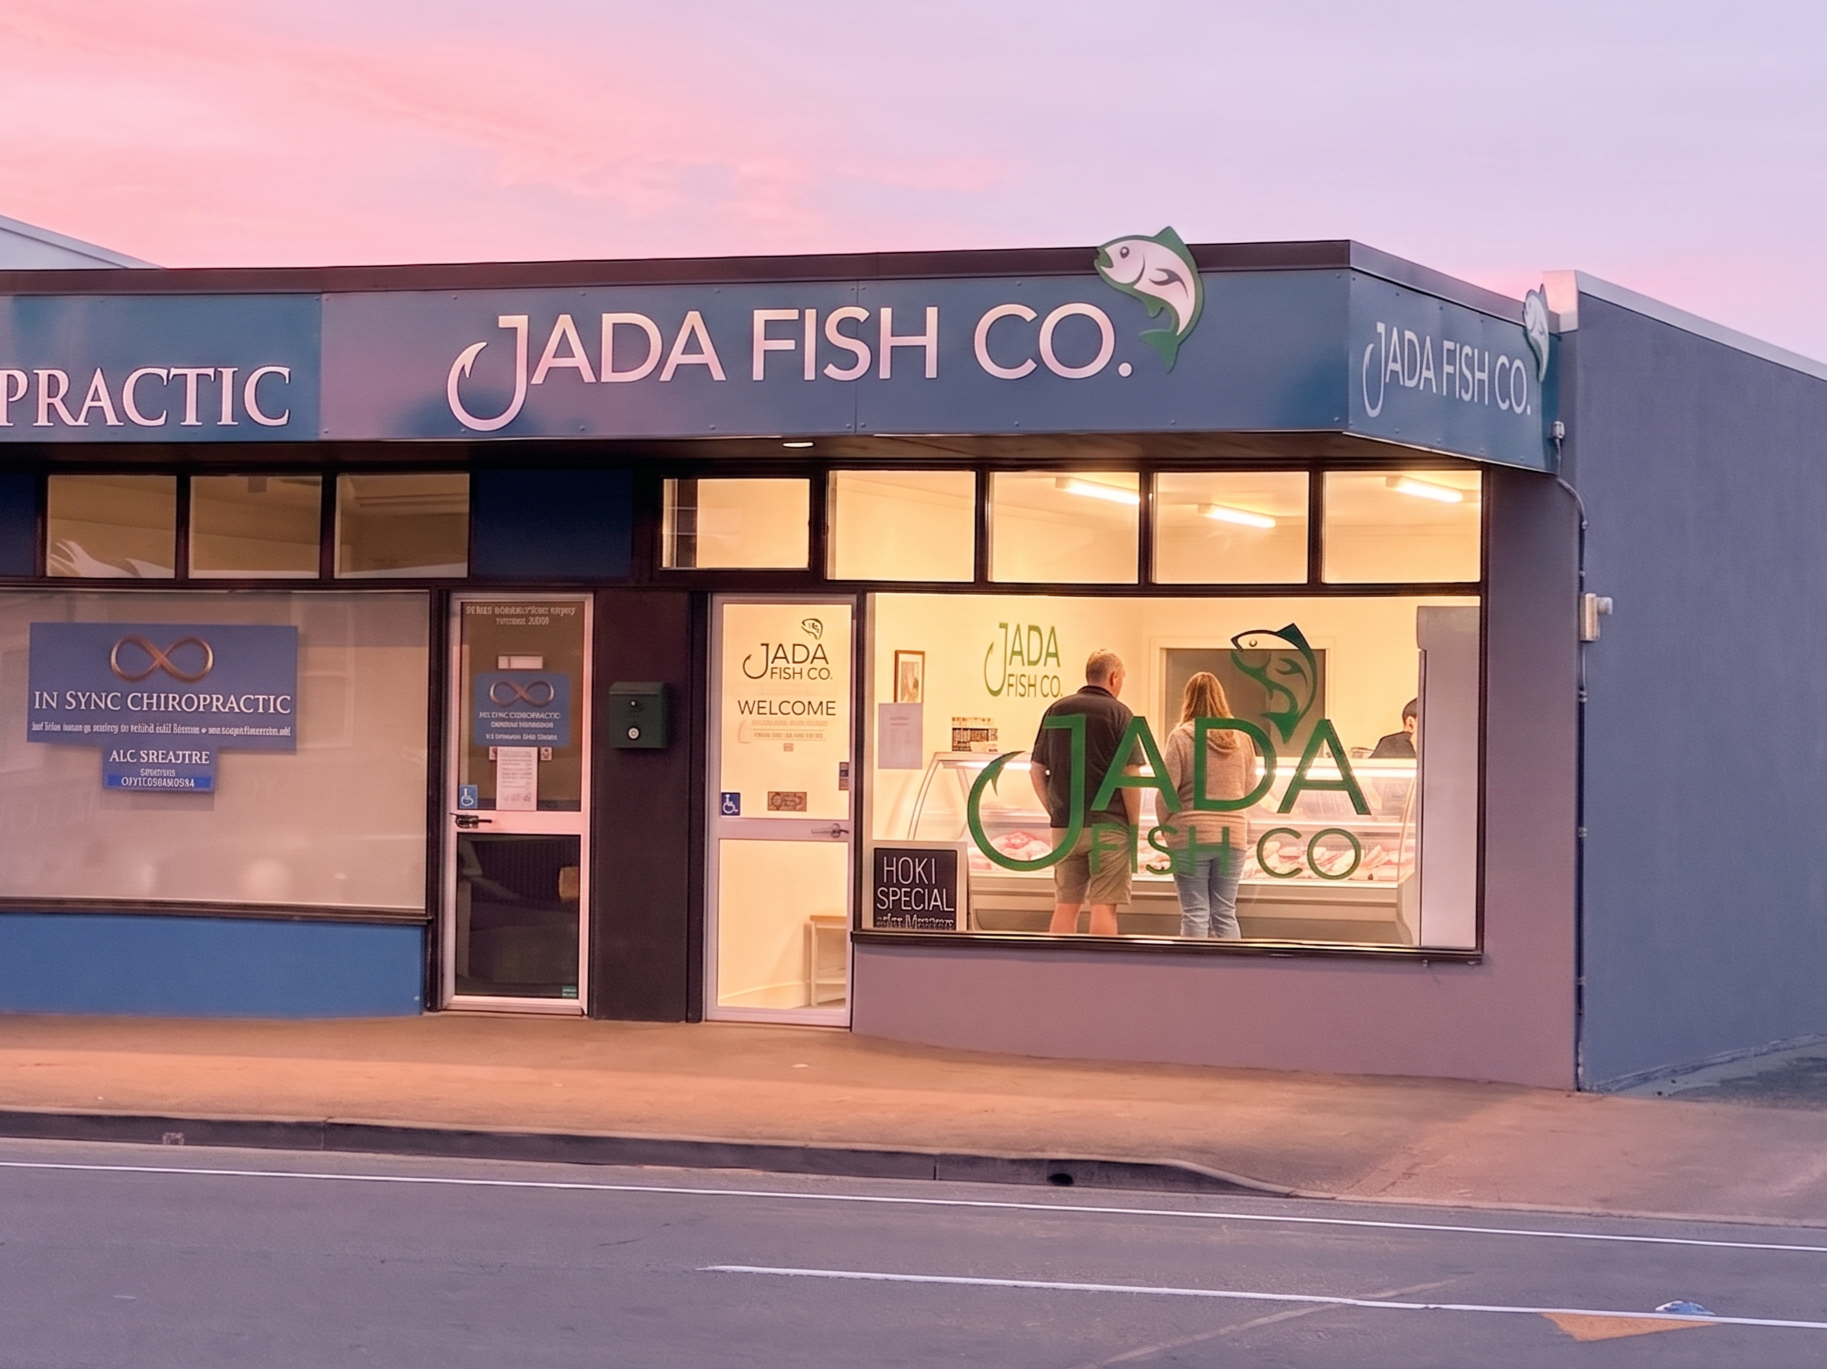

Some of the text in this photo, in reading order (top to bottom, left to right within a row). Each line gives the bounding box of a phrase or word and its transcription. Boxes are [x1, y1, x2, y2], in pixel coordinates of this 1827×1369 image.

[447, 302, 1133, 431] JADA FISH CO.
[1362, 321, 1531, 418] JADA FISH CO.
[0, 365, 290, 426] PRACTIC
[742, 643, 829, 680] JADA
[770, 667, 833, 681] FISH CO.
[984, 622, 1061, 697] JADA
[33, 690, 292, 714] IN SYNC CHIROPRACTIC
[1007, 673, 1063, 698] FISH CO.
[737, 700, 837, 716] WELCOME
[109, 750, 137, 762] ALC
[967, 713, 1372, 872] JADA
[1091, 823, 1362, 880] FISH CO
[883, 856, 936, 885] HOKI
[876, 887, 955, 912] SPECIAL
